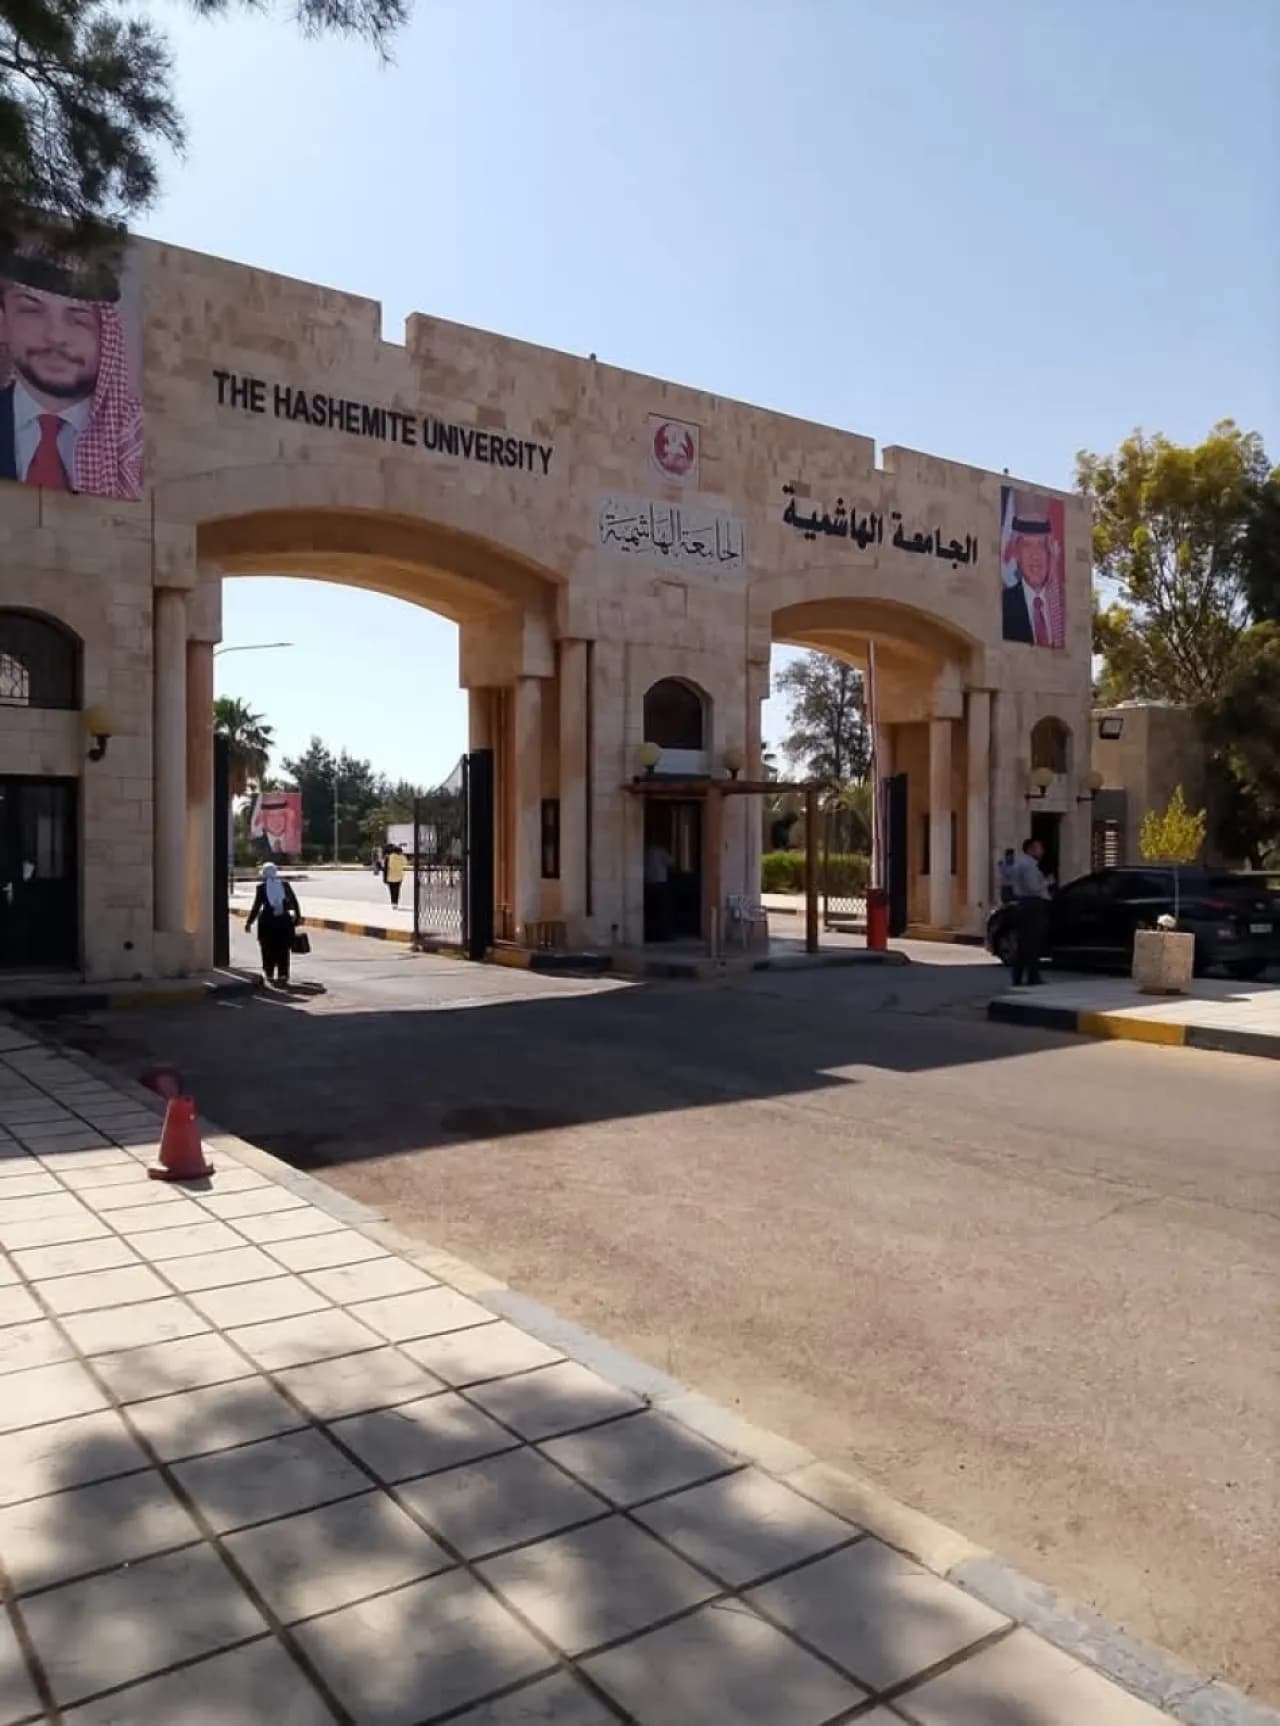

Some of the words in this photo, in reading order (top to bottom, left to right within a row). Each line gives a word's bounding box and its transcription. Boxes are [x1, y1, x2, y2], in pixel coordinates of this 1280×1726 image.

[212, 370, 266, 413] THE
[274, 384, 417, 447] HASHEMITE
[423, 416, 553, 475] UNIVERSITY
[600, 503, 681, 555] الهاشمية
[681, 515, 744, 568] الجامعة
[782, 484, 883, 549] الهاشمية
[893, 512, 978, 569] الجامعة
